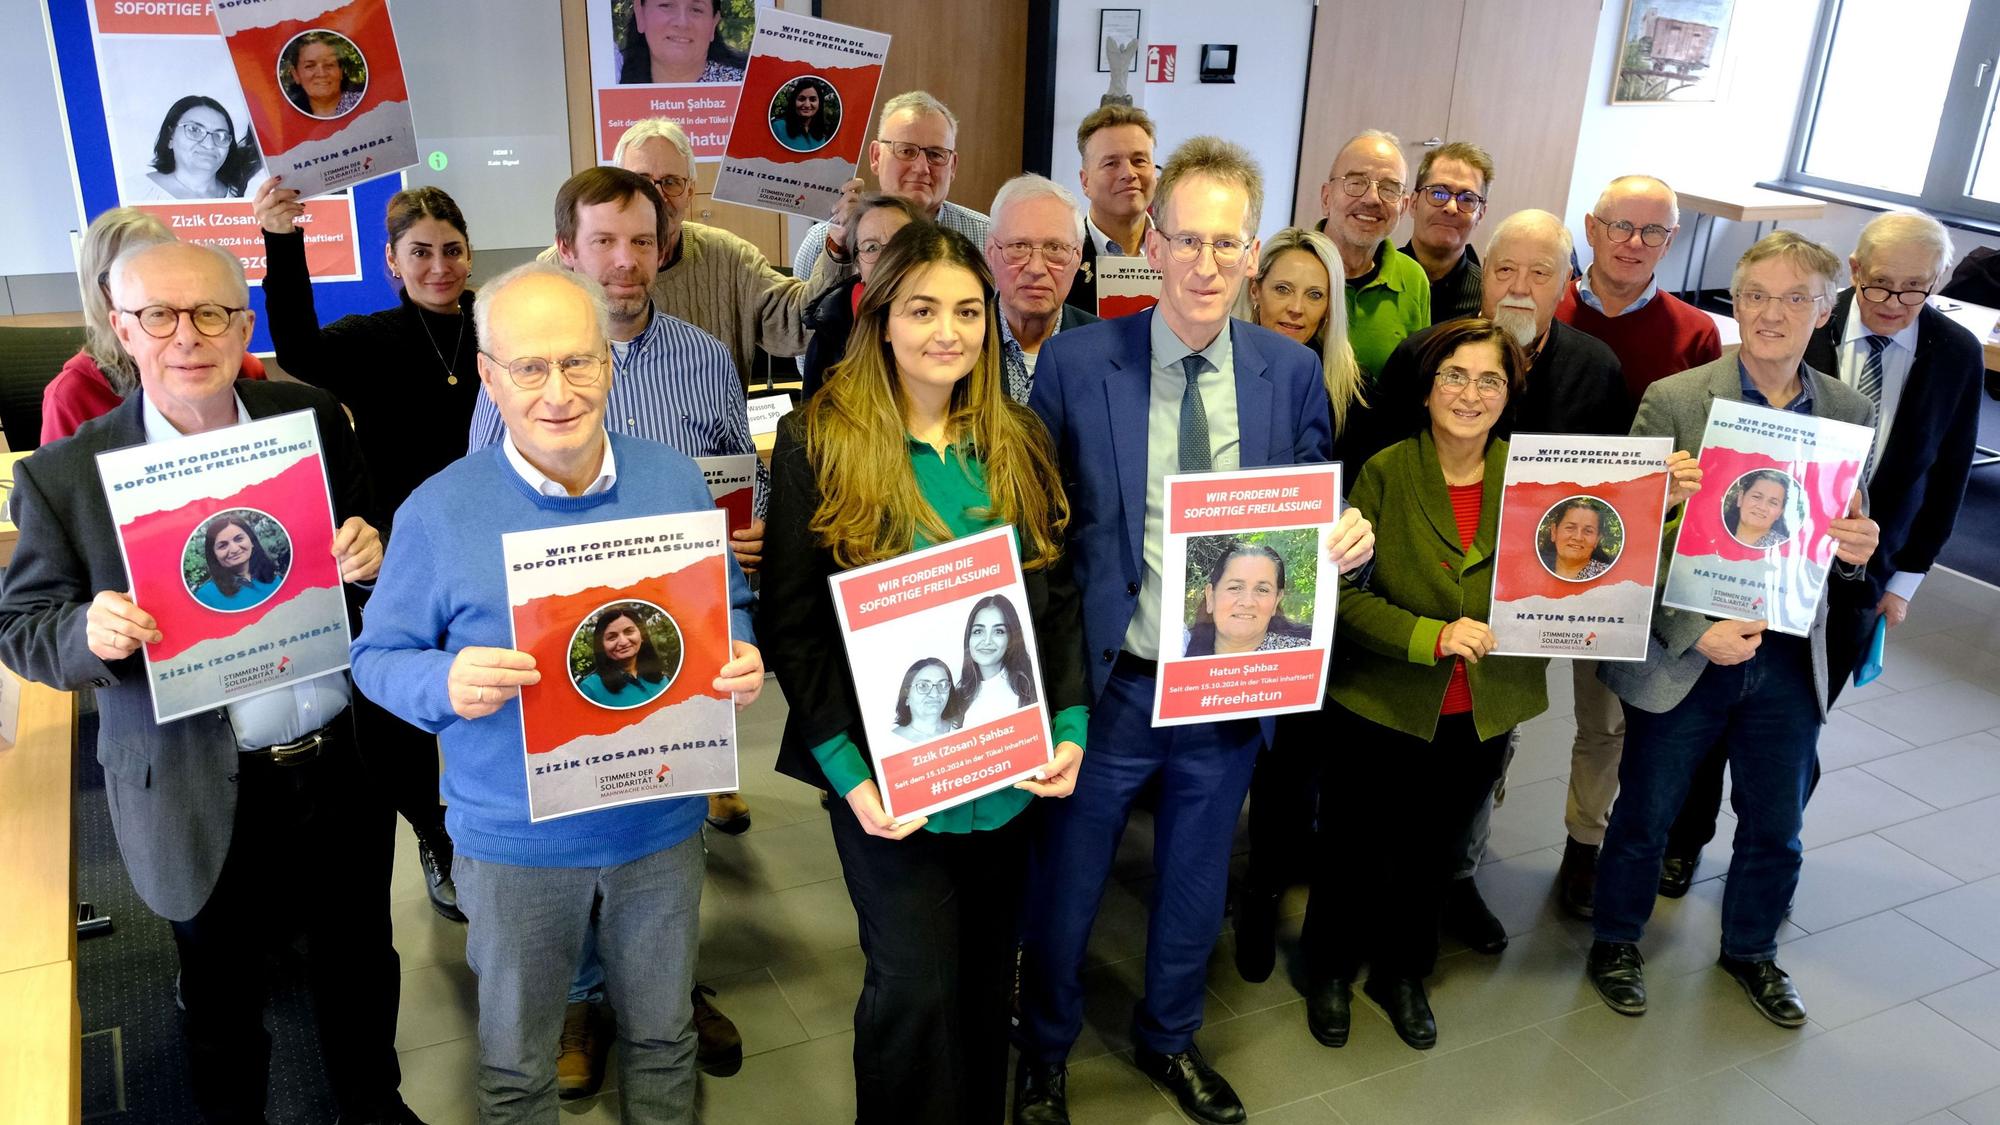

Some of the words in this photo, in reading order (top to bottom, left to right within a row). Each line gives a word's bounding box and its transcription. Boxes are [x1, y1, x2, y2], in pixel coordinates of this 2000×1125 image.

[114, 2, 201, 16] SOFORTIGE
[759, 28, 814, 45] SOFORTIGE
[816, 41, 883, 60] FREILASSUNG!
[782, 25, 801, 34] WIR
[802, 30, 847, 44] FORDERN
[848, 40, 864, 48] DIE
[650, 100, 684, 110] Hatun
[687, 98, 726, 112] Şahbaz
[608, 119, 624, 127] Seit
[293, 151, 339, 170] HATUN
[342, 135, 393, 157] ŞAHBAZ
[757, 172, 802, 186] (ZOSAN)
[172, 214, 206, 227] Zizik
[243, 237, 251, 245] in
[254, 236, 264, 245] de
[768, 411, 781, 419] SPD
[1737, 417, 1759, 426] WIR
[1712, 420, 1775, 438] SOFORTIGE
[144, 460, 175, 474] WIR
[178, 443, 250, 466] FORDERN
[254, 437, 279, 450] DIE
[1512, 455, 1579, 464] SOFORTIGE
[1580, 457, 1667, 467] FREILASSUNG!
[1538, 448, 1561, 456] WIR
[1563, 449, 1619, 457] FORDERN
[113, 466, 203, 492] SOFORTIGE
[206, 439, 313, 471] FREILASSUNG!
[1206, 491, 1227, 503] WIR
[1229, 489, 1279, 501] FORDERN
[1281, 486, 1300, 498] DIE
[1184, 505, 1246, 519] SOFORTIGE
[1247, 499, 1322, 515] FREILASSUNG!
[545, 546, 576, 557] WIR
[580, 535, 655, 552] FORDERN
[659, 532, 685, 542] DIE
[512, 552, 603, 572] SOFORTIGE
[607, 539, 720, 559] FREILASSUNG!
[878, 579, 900, 593] WIR
[902, 563, 953, 587] FORDERN
[955, 556, 974, 570] DIE
[1693, 568, 1737, 583] HATUN
[859, 588, 922, 614] SOFORTIGE
[923, 563, 1000, 595] FREILASSUNG!
[1516, 613, 1564, 621] HATUN
[1567, 615, 1625, 624] ŞAHBAZ
[208, 642, 275, 667] (ZOSAN)
[278, 622, 342, 648] ŞAHBAZ
[224, 666, 258, 681] STIMMEN
[260, 662, 275, 671] DER
[224, 669, 274, 688] SOLIDARITÄT
[1209, 667, 1241, 677] Hatun
[1242, 663, 1279, 676] Şahbaz
[1184, 684, 1199, 692] dem
[1200, 680, 1239, 690] 15.10.2024
[1200, 690, 1282, 707] #freehatun
[911, 751, 938, 767] Zizik
[939, 737, 977, 759] (Zosan)
[978, 725, 1015, 746] Şahbaz
[535, 759, 581, 775] ZİZİK
[586, 746, 655, 766] (ZOSAN)
[659, 738, 729, 755] ŞAHBAZ
[600, 771, 636, 784] STIMMEN
[638, 768, 654, 776] DER
[894, 780, 909, 790] Seit
[909, 775, 926, 784] dem
[926, 761, 965, 779] 15.10.2024
[973, 754, 985, 763] der
[930, 759, 1012, 796] #freezosan
[600, 776, 652, 791] SOLIDARITÄT
[600, 786, 640, 798] MAHNWACHE
